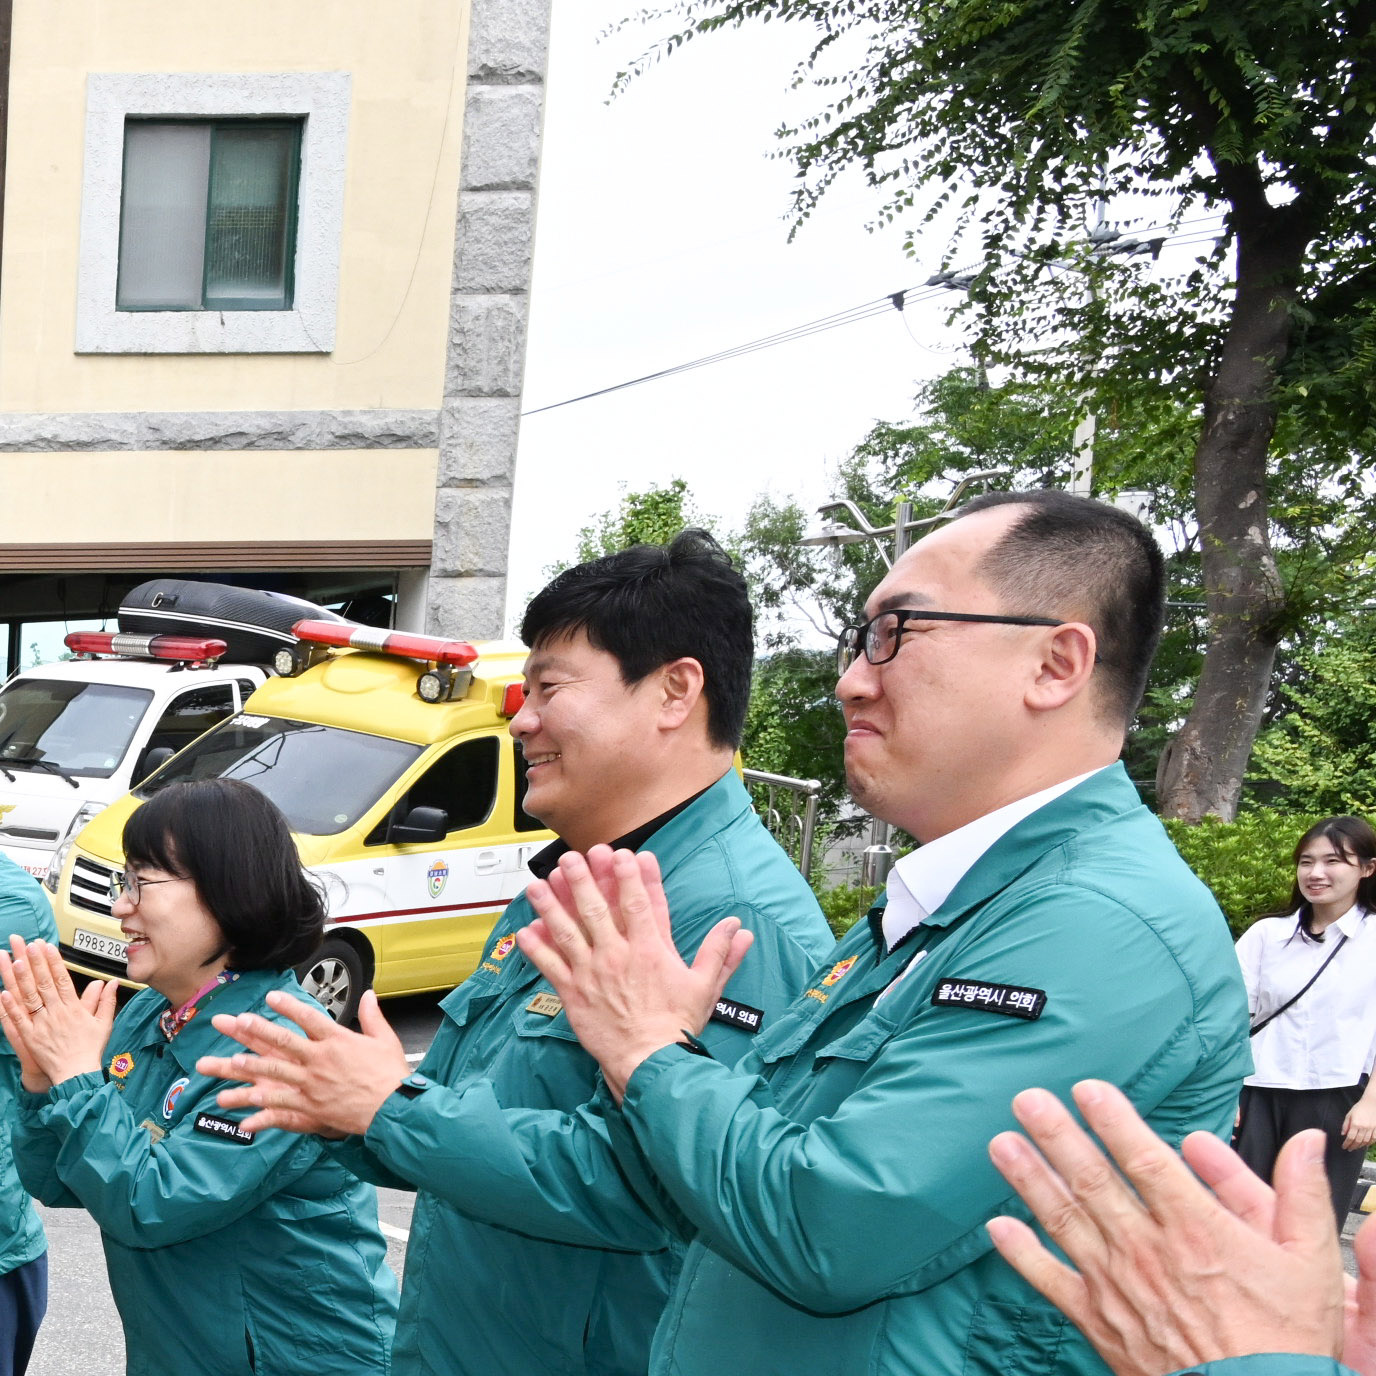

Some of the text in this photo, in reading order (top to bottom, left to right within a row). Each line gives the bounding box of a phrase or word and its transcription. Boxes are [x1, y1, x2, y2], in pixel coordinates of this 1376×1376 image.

[78, 932, 105, 953] 998오
[938, 983, 1038, 1012] 울산광역시 의회
[736, 1008, 759, 1027] 의회
[198, 1116, 235, 1136] 울산광역시
